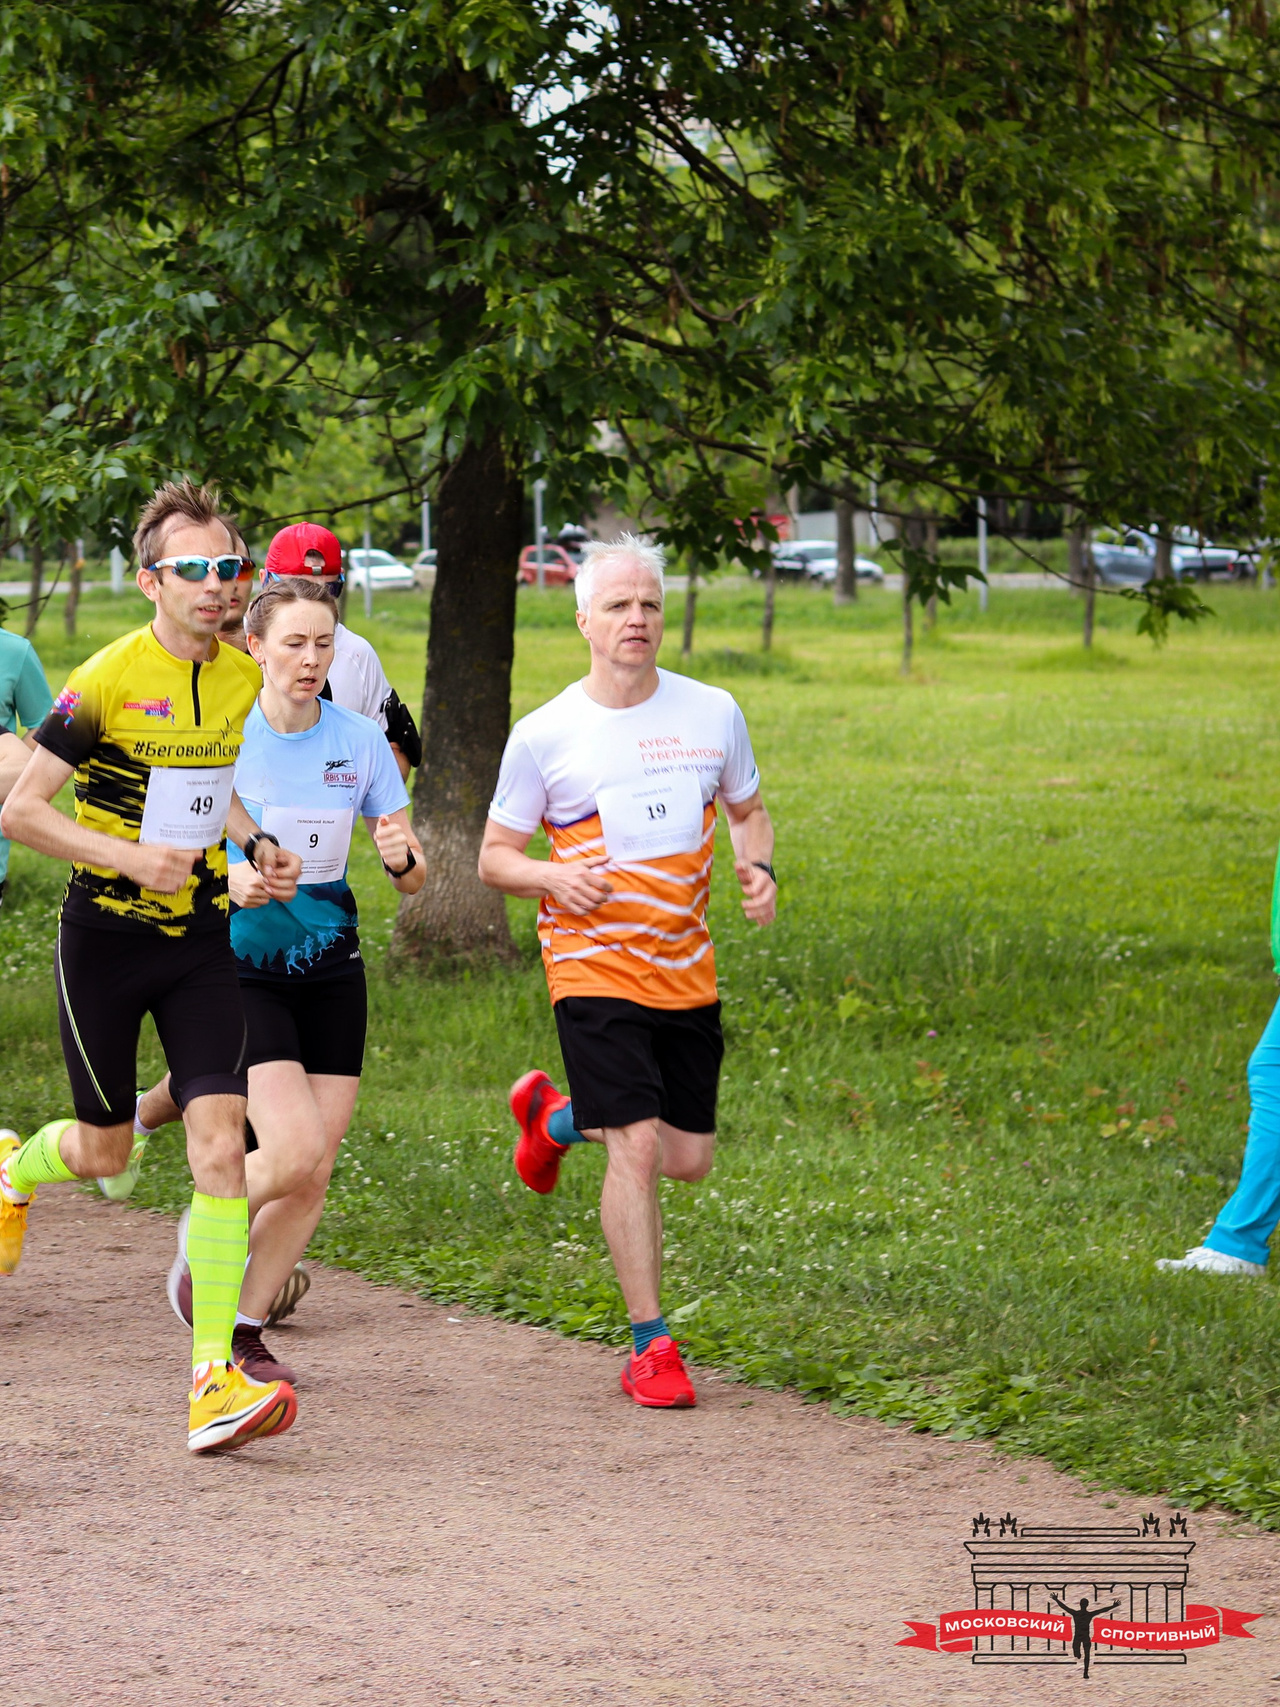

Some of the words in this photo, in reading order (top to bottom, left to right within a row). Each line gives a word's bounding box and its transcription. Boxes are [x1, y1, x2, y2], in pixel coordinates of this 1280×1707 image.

[638, 736, 681, 749] КУБОК
[323, 773, 339, 782] IRBIS
[341, 773, 357, 782] TEAM
[189, 795, 214, 816] 49
[646, 803, 667, 821] 19
[309, 833, 319, 849] 9
